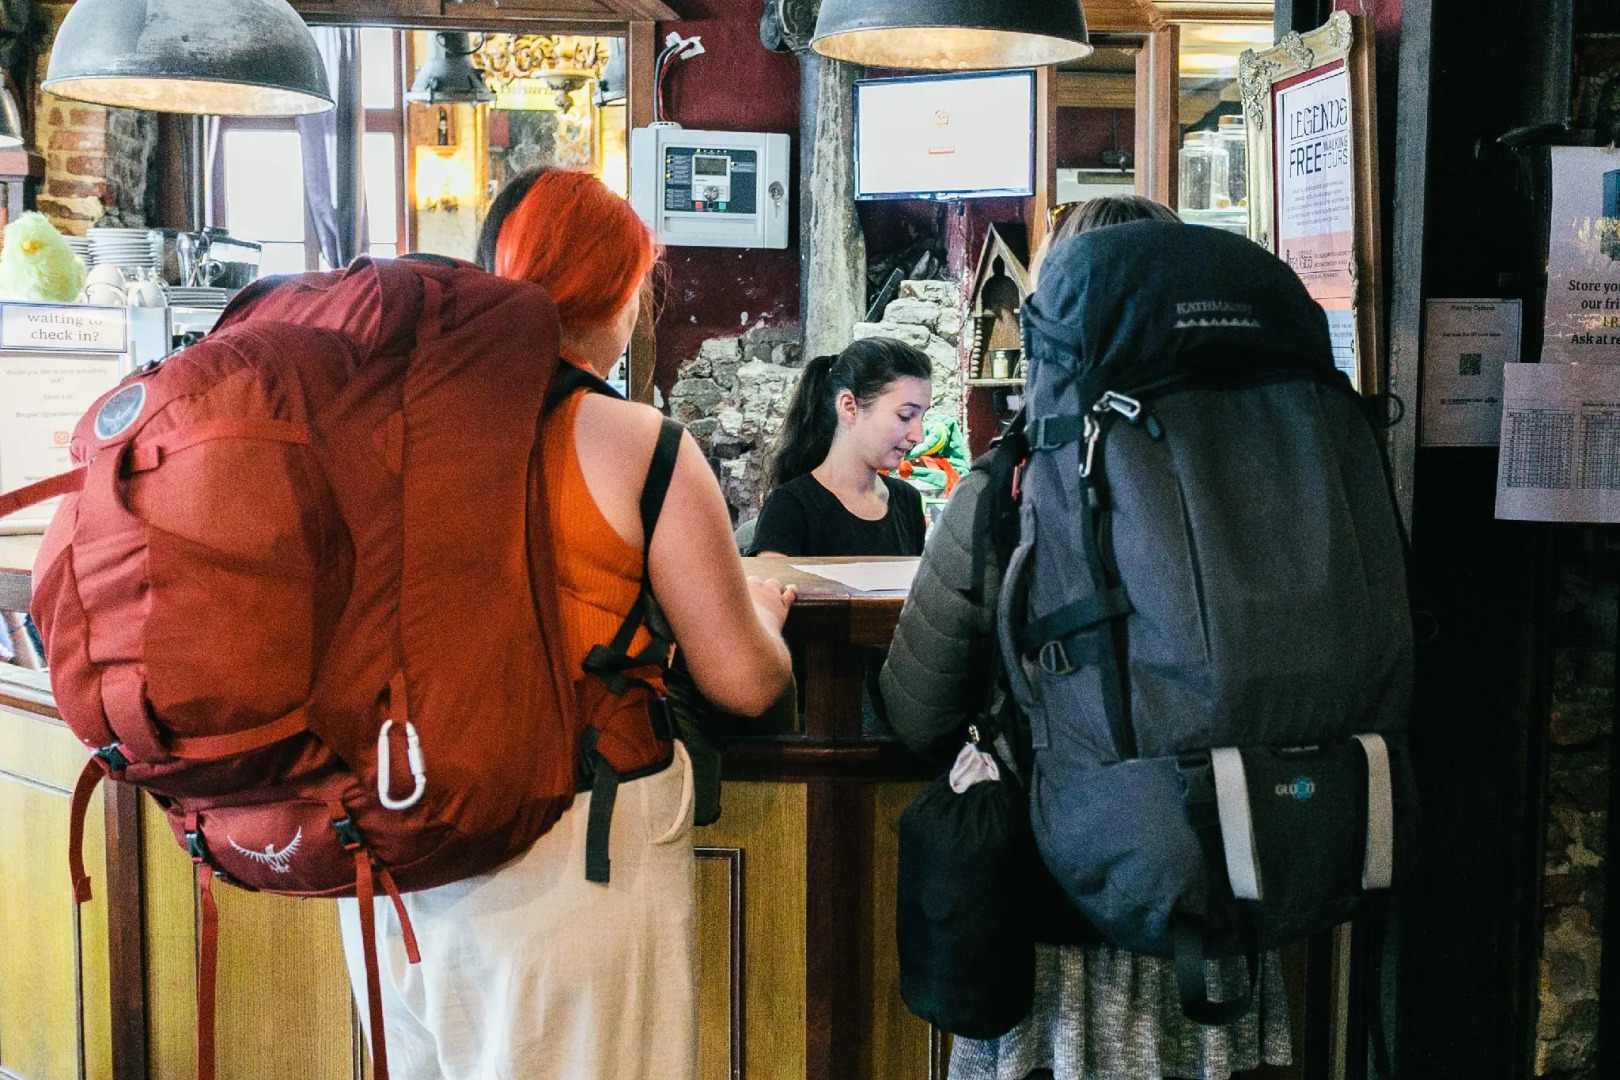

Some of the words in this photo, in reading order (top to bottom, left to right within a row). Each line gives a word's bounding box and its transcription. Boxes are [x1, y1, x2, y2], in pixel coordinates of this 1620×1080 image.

[1290, 97, 1348, 140] LEGENDS
[1323, 135, 1348, 151] WALKING
[1289, 142, 1322, 178] FREE
[1323, 147, 1348, 168] TOURS
[1568, 279, 1601, 292] Store
[1581, 300, 1603, 309] our
[27, 313, 84, 328] waiting
[31, 328, 73, 341] check
[79, 330, 100, 342] in?
[1571, 332, 1594, 344] Ask
[1596, 334, 1608, 345] at
